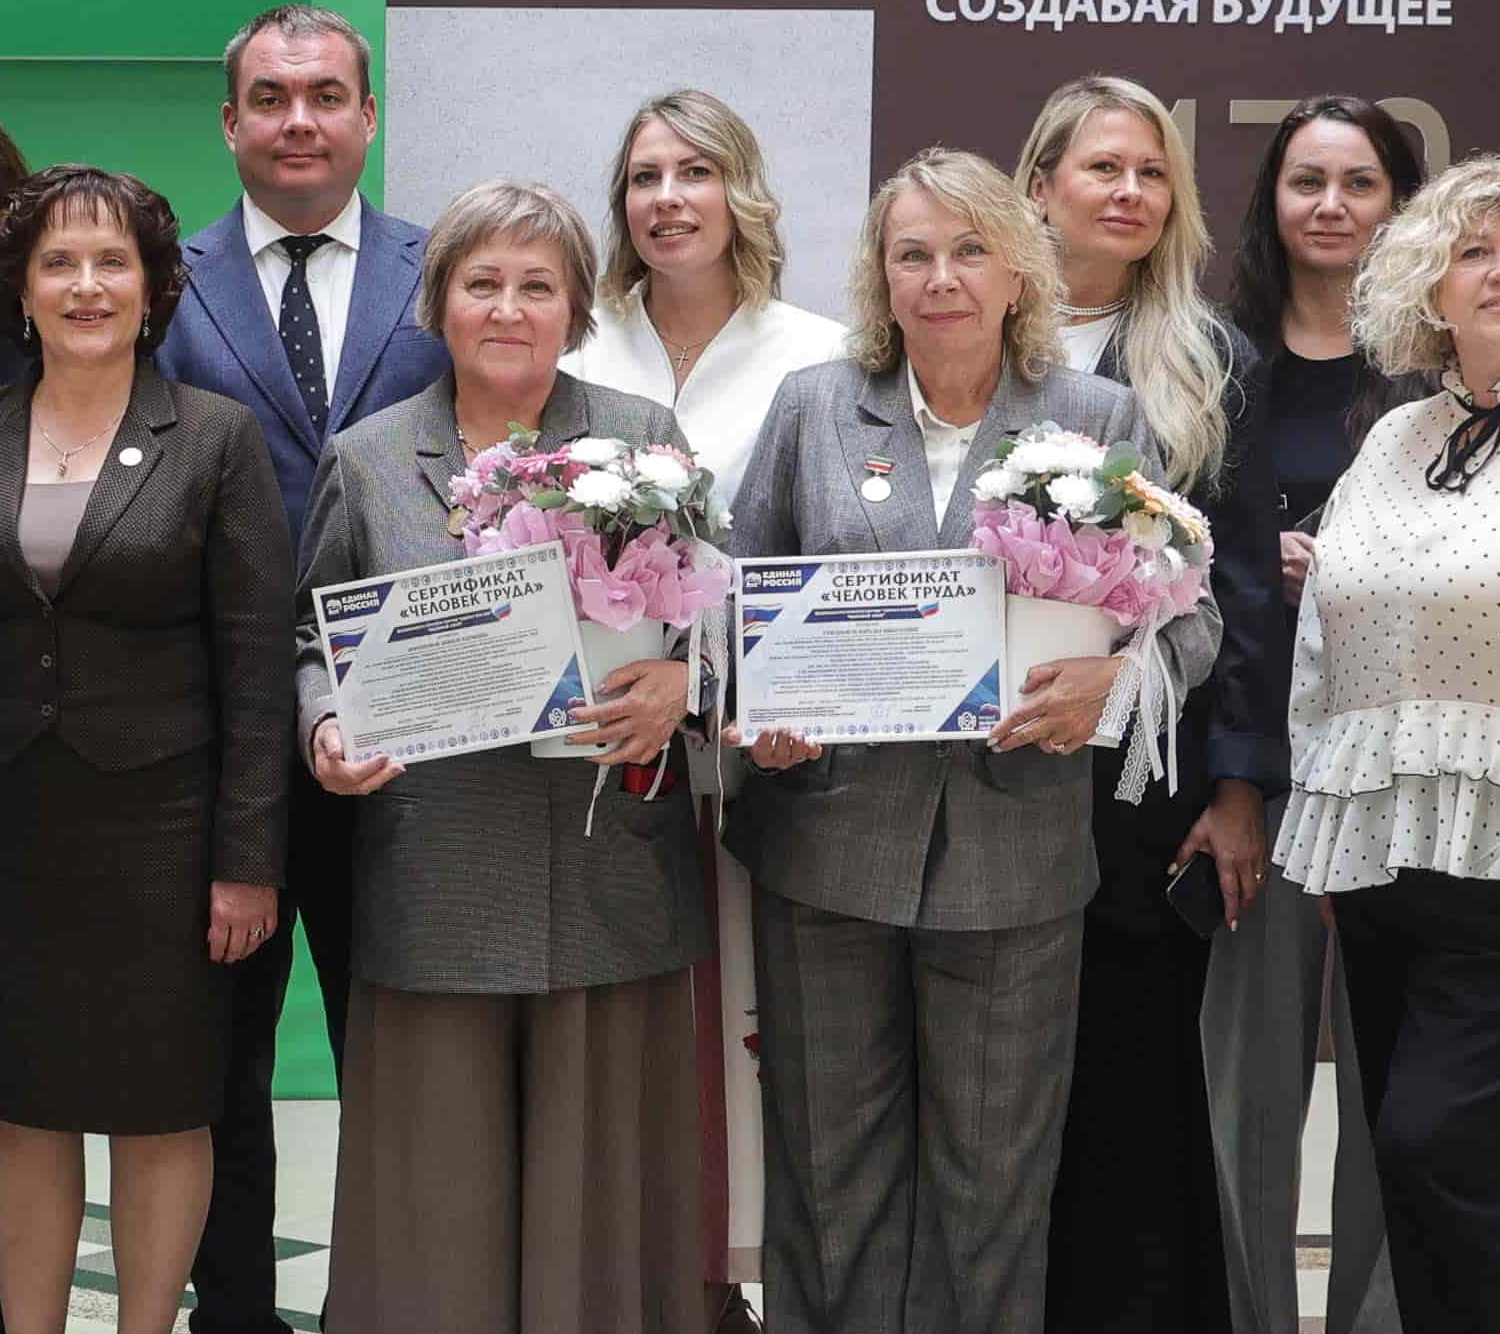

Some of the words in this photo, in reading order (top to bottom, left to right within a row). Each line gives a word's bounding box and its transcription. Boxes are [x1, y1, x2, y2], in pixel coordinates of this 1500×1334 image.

[407, 568, 526, 602] СЕРТИФИКАТ
[832, 570, 961, 588] СЕРТИФИКАТ
[399, 593, 482, 619] «ЧЕЛОВЕК
[484, 581, 545, 602] ТРУДА»
[821, 587, 908, 603] «ЧЕЛОВЕК
[913, 585, 977, 599] ТРУДА»
